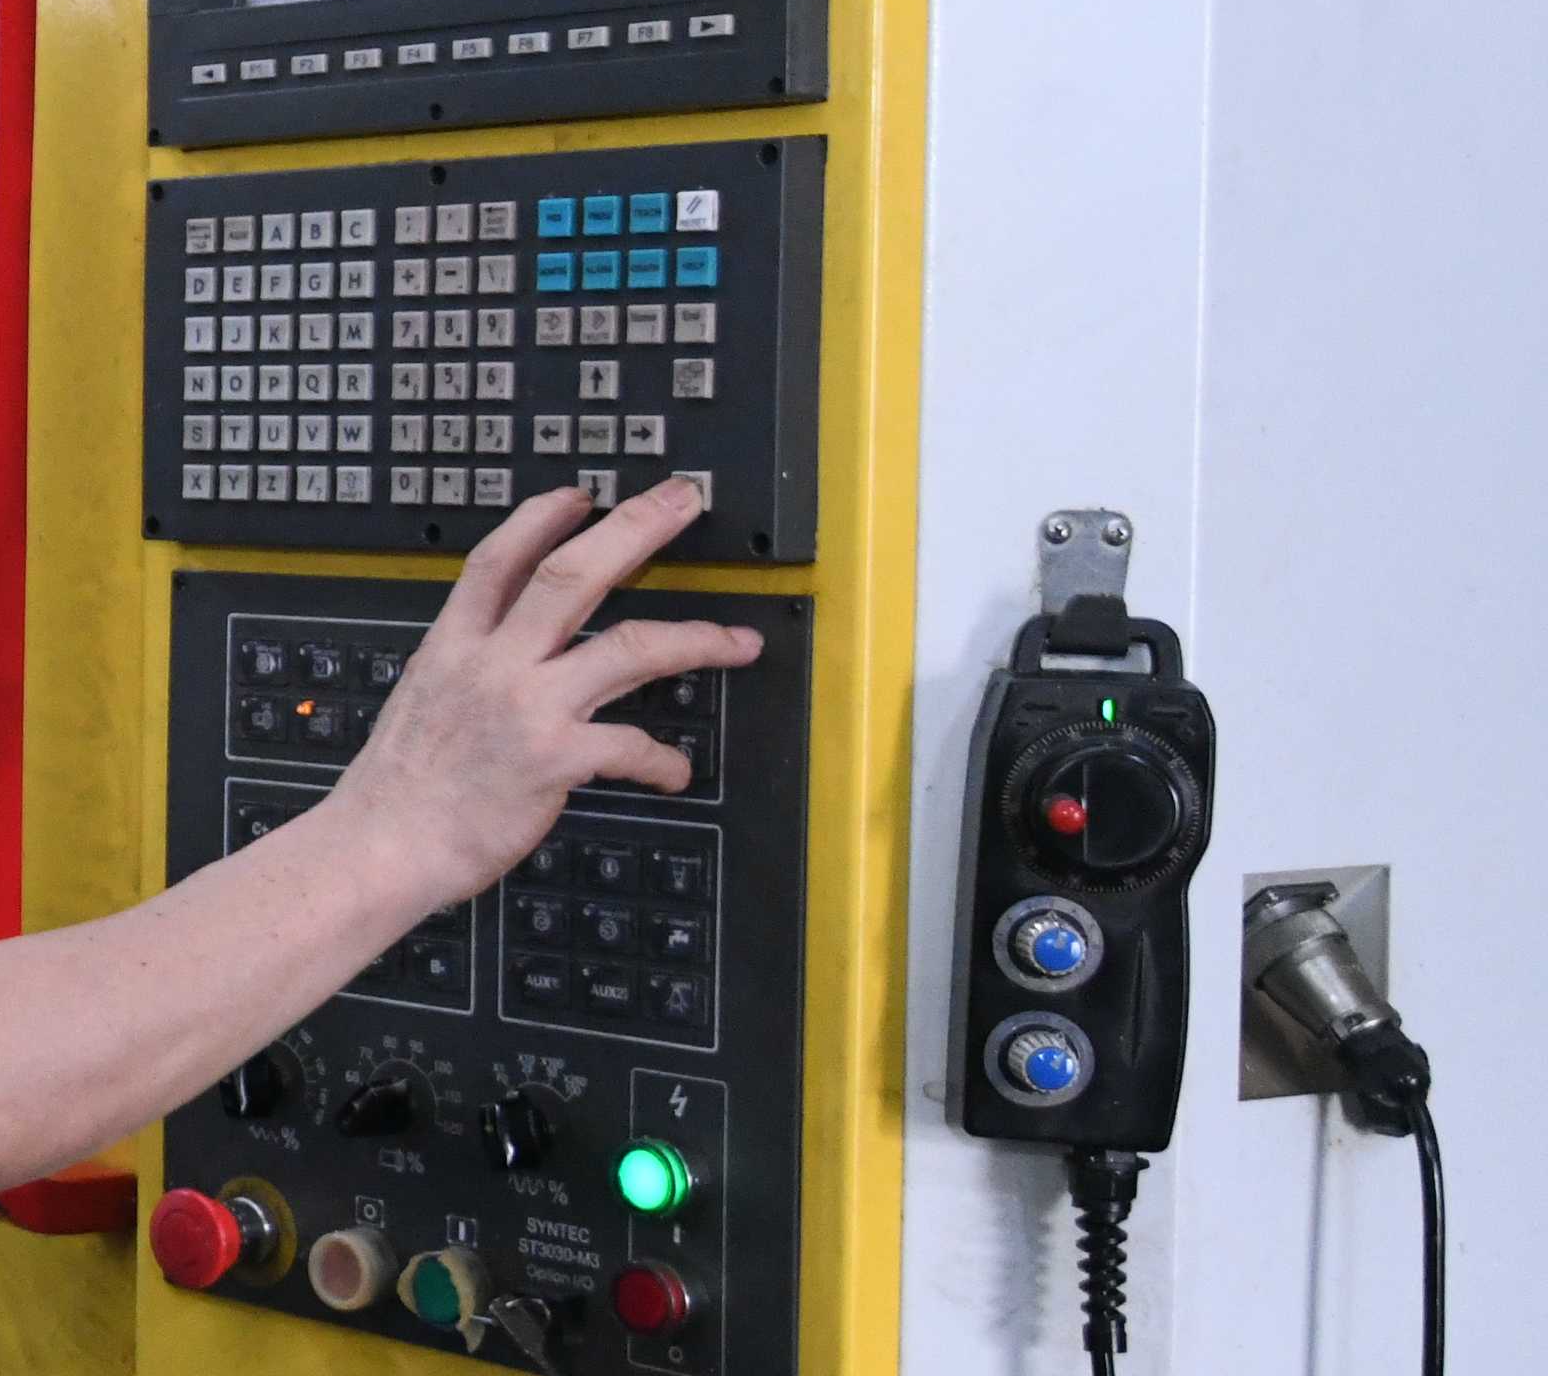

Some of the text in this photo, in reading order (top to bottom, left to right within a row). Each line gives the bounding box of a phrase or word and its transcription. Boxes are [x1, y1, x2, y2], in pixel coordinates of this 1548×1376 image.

[578, 31, 593, 45] F7
[270, 226, 283, 242] A
[310, 224, 322, 240] B
[349, 222, 361, 238] C
[193, 278, 204, 295] D
[232, 277, 243, 293] E
[270, 276, 281, 293] F
[308, 274, 321, 291] G
[348, 272, 361, 289] H
[400, 320, 412, 338] 7
[445, 317, 454, 335] 8
[487, 314, 497, 332] 9
[196, 328, 201, 343] I
[231, 327, 242, 343] J
[269, 326, 280, 343] K
[309, 325, 320, 341] L
[346, 325, 362, 340] M
[347, 375, 359, 392] R
[399, 372, 410, 387] 4
[444, 367, 453, 384] 5
[486, 367, 496, 385] 6
[192, 378, 204, 392] N
[229, 376, 242, 392] O
[269, 376, 280, 392] P
[306, 374, 320, 394] Q
[191, 426, 204, 442] S
[229, 426, 241, 442] T
[268, 426, 280, 442] U
[305, 426, 318, 441] V
[343, 426, 361, 441] W
[441, 419, 451, 437] 2
[484, 419, 493, 437] 3
[190, 475, 202, 490] X
[227, 475, 240, 490] Y
[266, 475, 276, 491] Z
[399, 473, 410, 490] 0
[526, 1216, 590, 1244] SYNTEC
